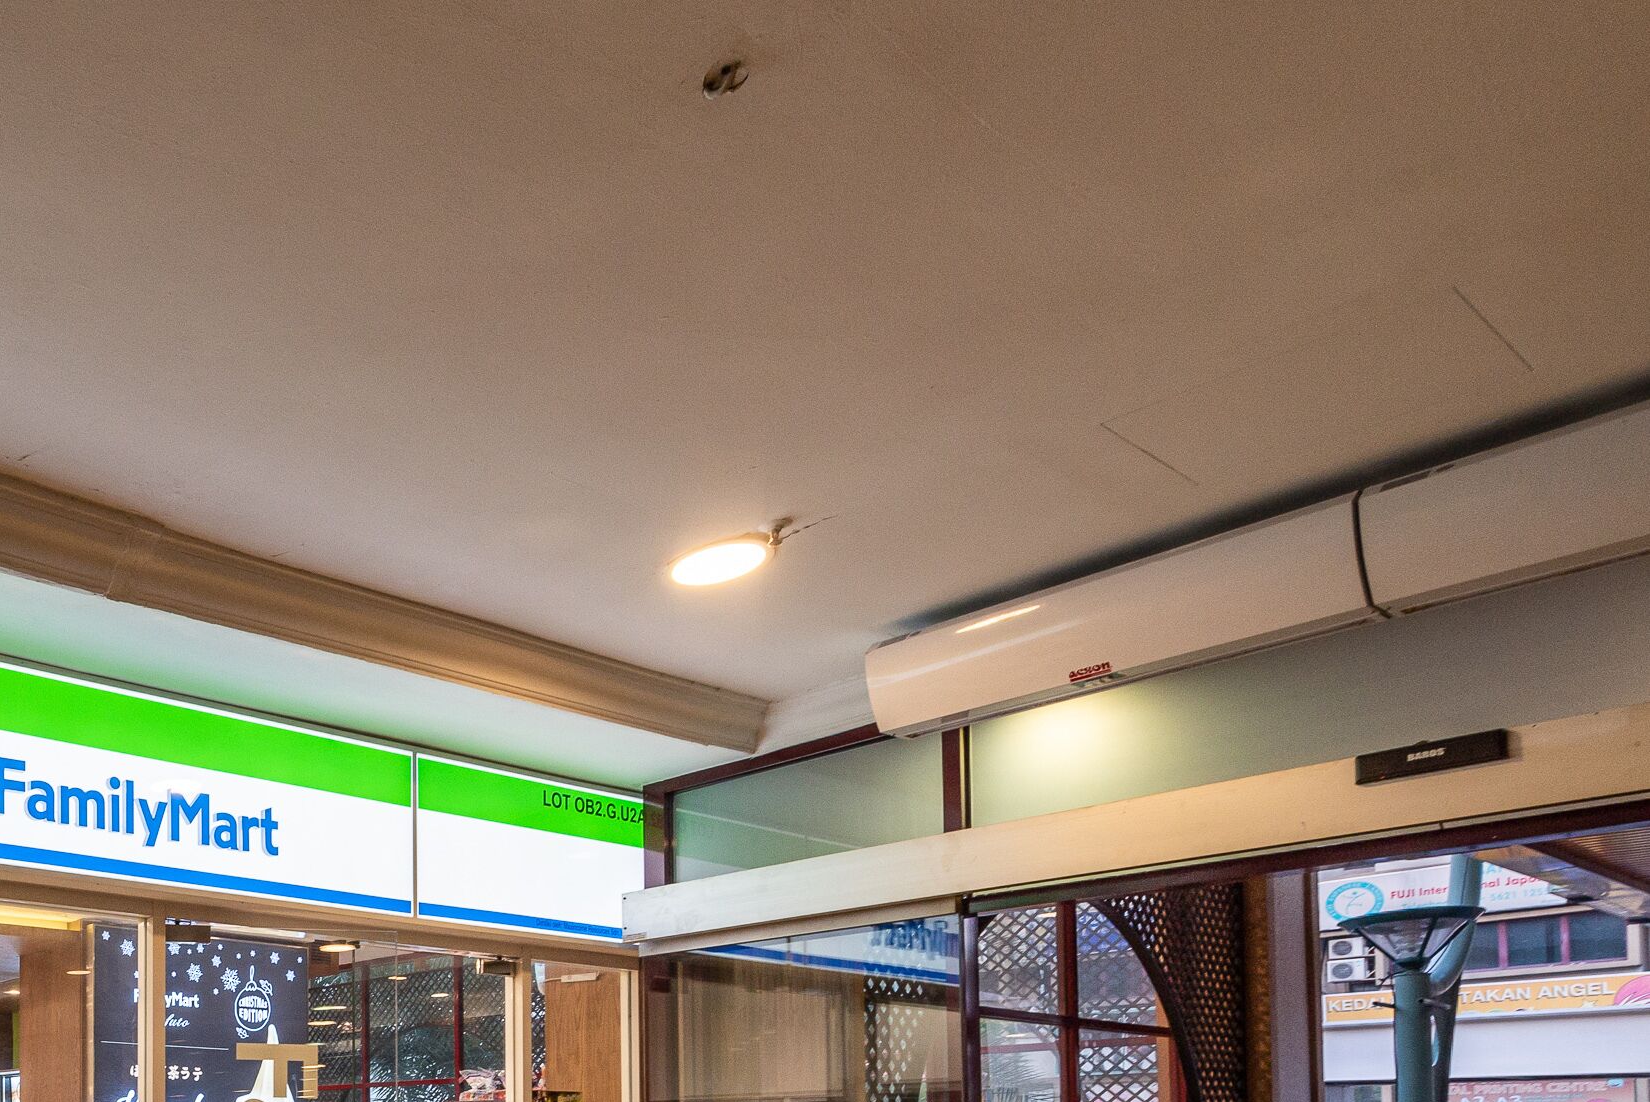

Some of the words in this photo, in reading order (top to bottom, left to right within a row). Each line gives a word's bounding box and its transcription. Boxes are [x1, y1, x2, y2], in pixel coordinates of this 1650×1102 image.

[542, 789, 571, 811] LOT
[1389, 889, 1415, 900] FUJI
[1537, 981, 1616, 999] ANGEL
[238, 995, 268, 1009] CHRISTMAS
[238, 1008, 268, 1023] EDITION
[130, 1064, 203, 1082] ほ茶ラテ
